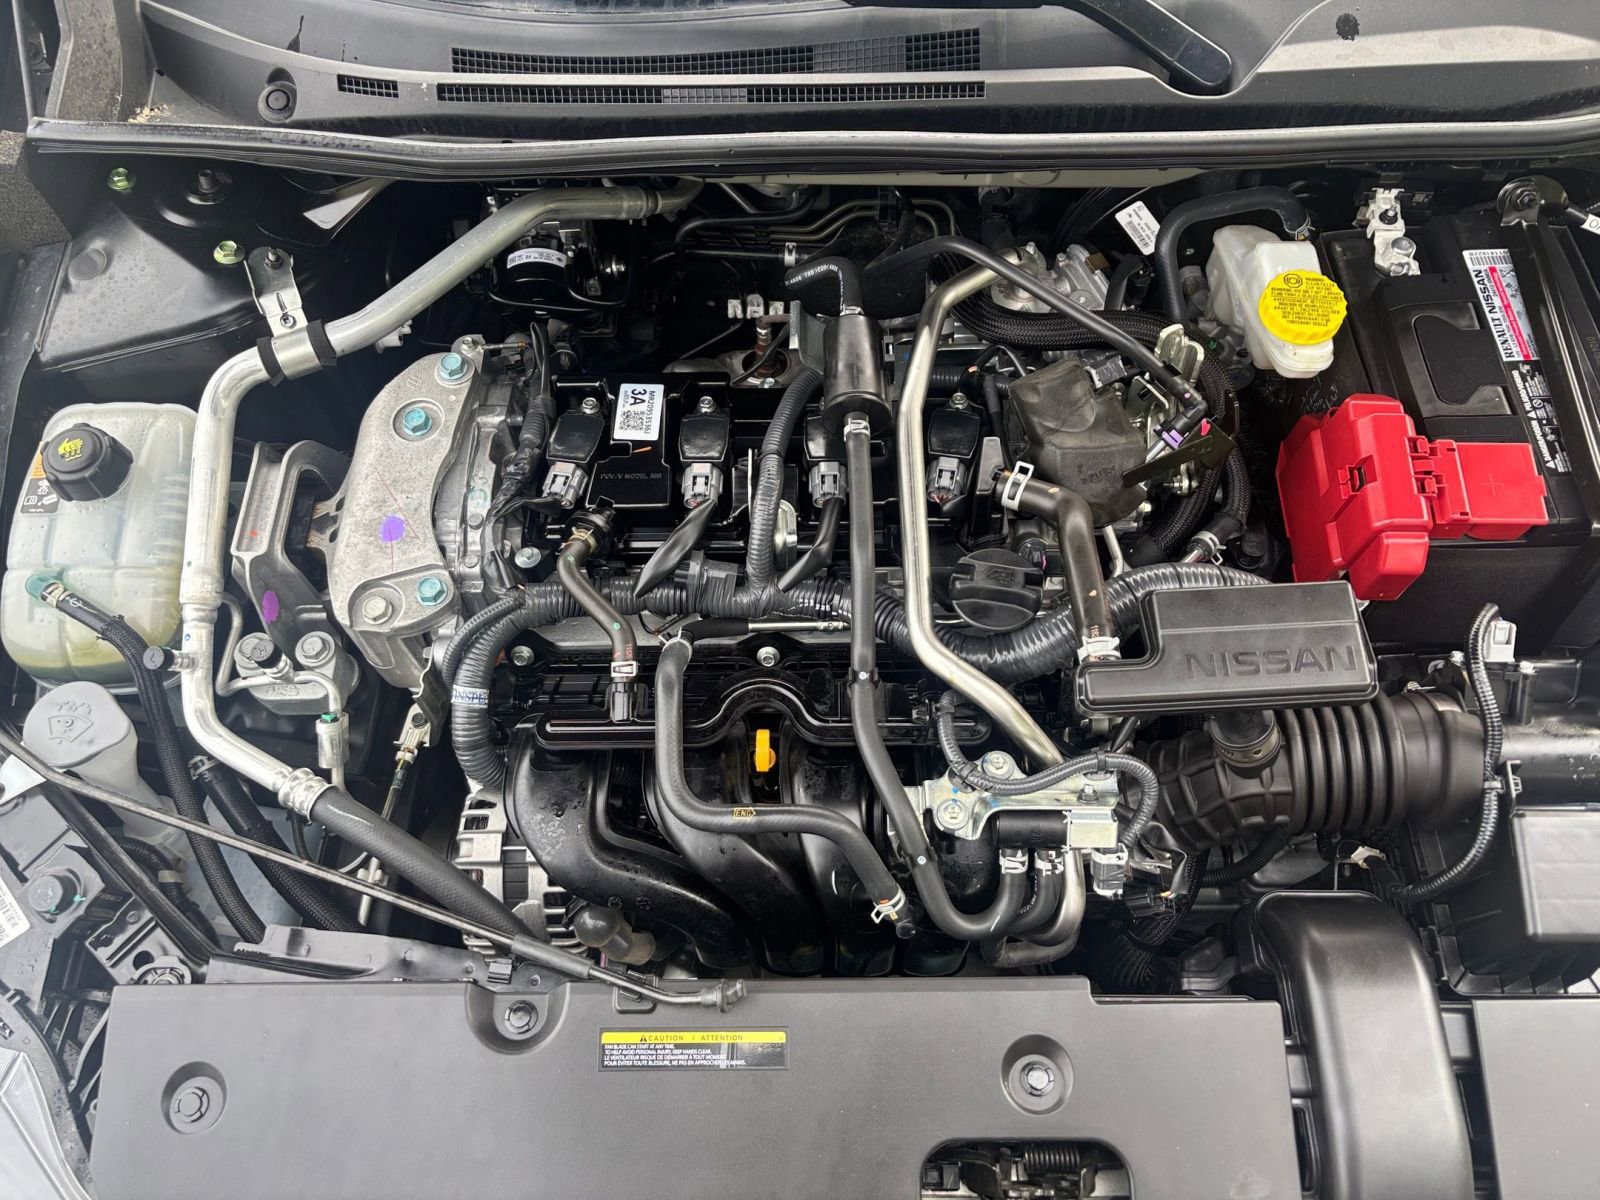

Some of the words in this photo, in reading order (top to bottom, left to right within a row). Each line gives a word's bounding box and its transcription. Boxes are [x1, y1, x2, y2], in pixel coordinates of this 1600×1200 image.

[1473, 270, 1497, 315] NISSAN
[1492, 317, 1514, 359] RENAULT
[630, 389, 647, 406] 3A
[1512, 370, 1532, 411] PELIGRO/VENENO
[1531, 420, 1551, 460] DANGER/POISON
[1185, 646, 1357, 680] NISSAN
